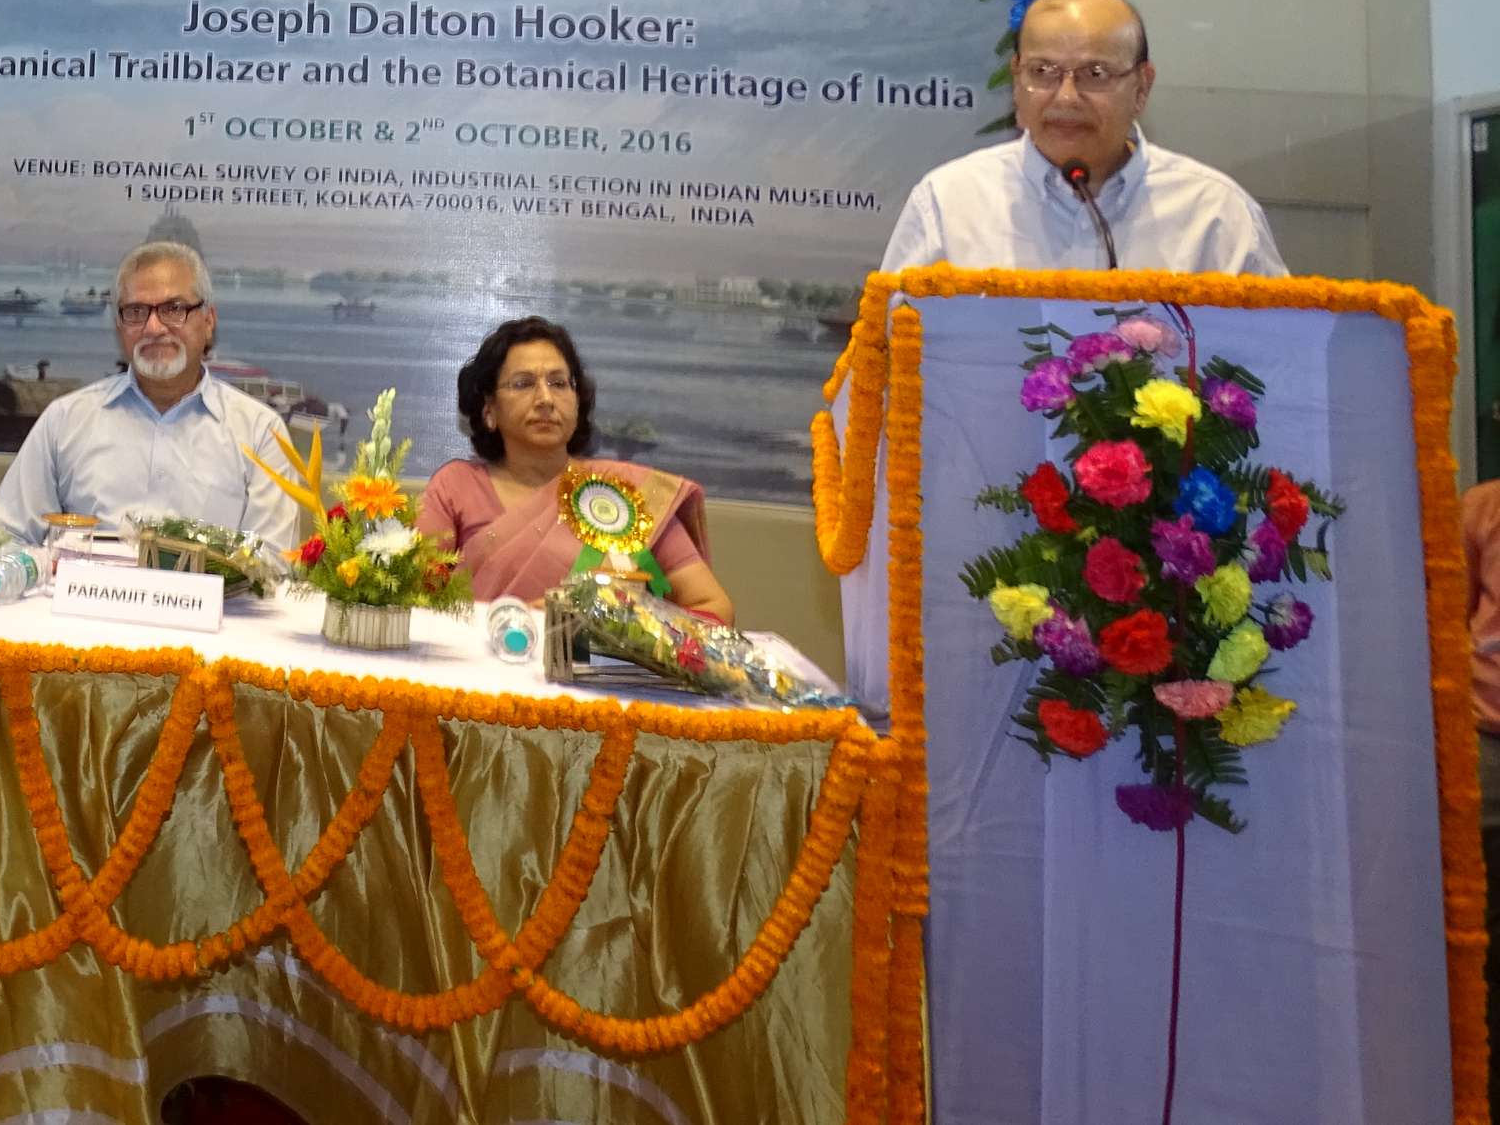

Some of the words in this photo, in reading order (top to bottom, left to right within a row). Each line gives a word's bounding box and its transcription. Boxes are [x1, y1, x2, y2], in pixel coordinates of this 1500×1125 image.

[183, 0, 330, 42] Joseph
[350, 2, 496, 37] Dalton
[515, 6, 694, 43] Hooker:
[108, 52, 292, 82] Trailblazer
[302, 55, 369, 84] and
[381, 59, 442, 85] the
[456, 58, 627, 91] Botanical
[642, 65, 807, 107] Heritage
[821, 73, 863, 103] of
[877, 77, 974, 108] India
[225, 117, 363, 142] OCTOBER
[374, 121, 396, 142] &
[455, 123, 608, 154] OCTOBER,
[620, 130, 692, 154] 2016
[13, 158, 86, 176] VENUE:
[93, 160, 209, 179] BOTANICAL
[215, 163, 297, 182] SURVEY
[303, 166, 332, 184] OF
[338, 168, 404, 188] INDIA,
[412, 170, 542, 191] INDUSTRIAL
[548, 174, 643, 196] SECTION
[649, 179, 673, 196] IN
[680, 181, 761, 203] INDIAN
[769, 186, 883, 212] MUSEUM,
[124, 184, 134, 201] 1
[141, 184, 225, 202] SUDDER
[231, 186, 308, 208] STREET,
[316, 190, 504, 214] KOLKATA-700016,
[512, 196, 575, 216] WEST
[581, 200, 676, 223] BENGAL,
[690, 206, 756, 227] INDIA
[67, 583, 148, 604] PARAMJIT
[152, 593, 203, 612] SINGH
